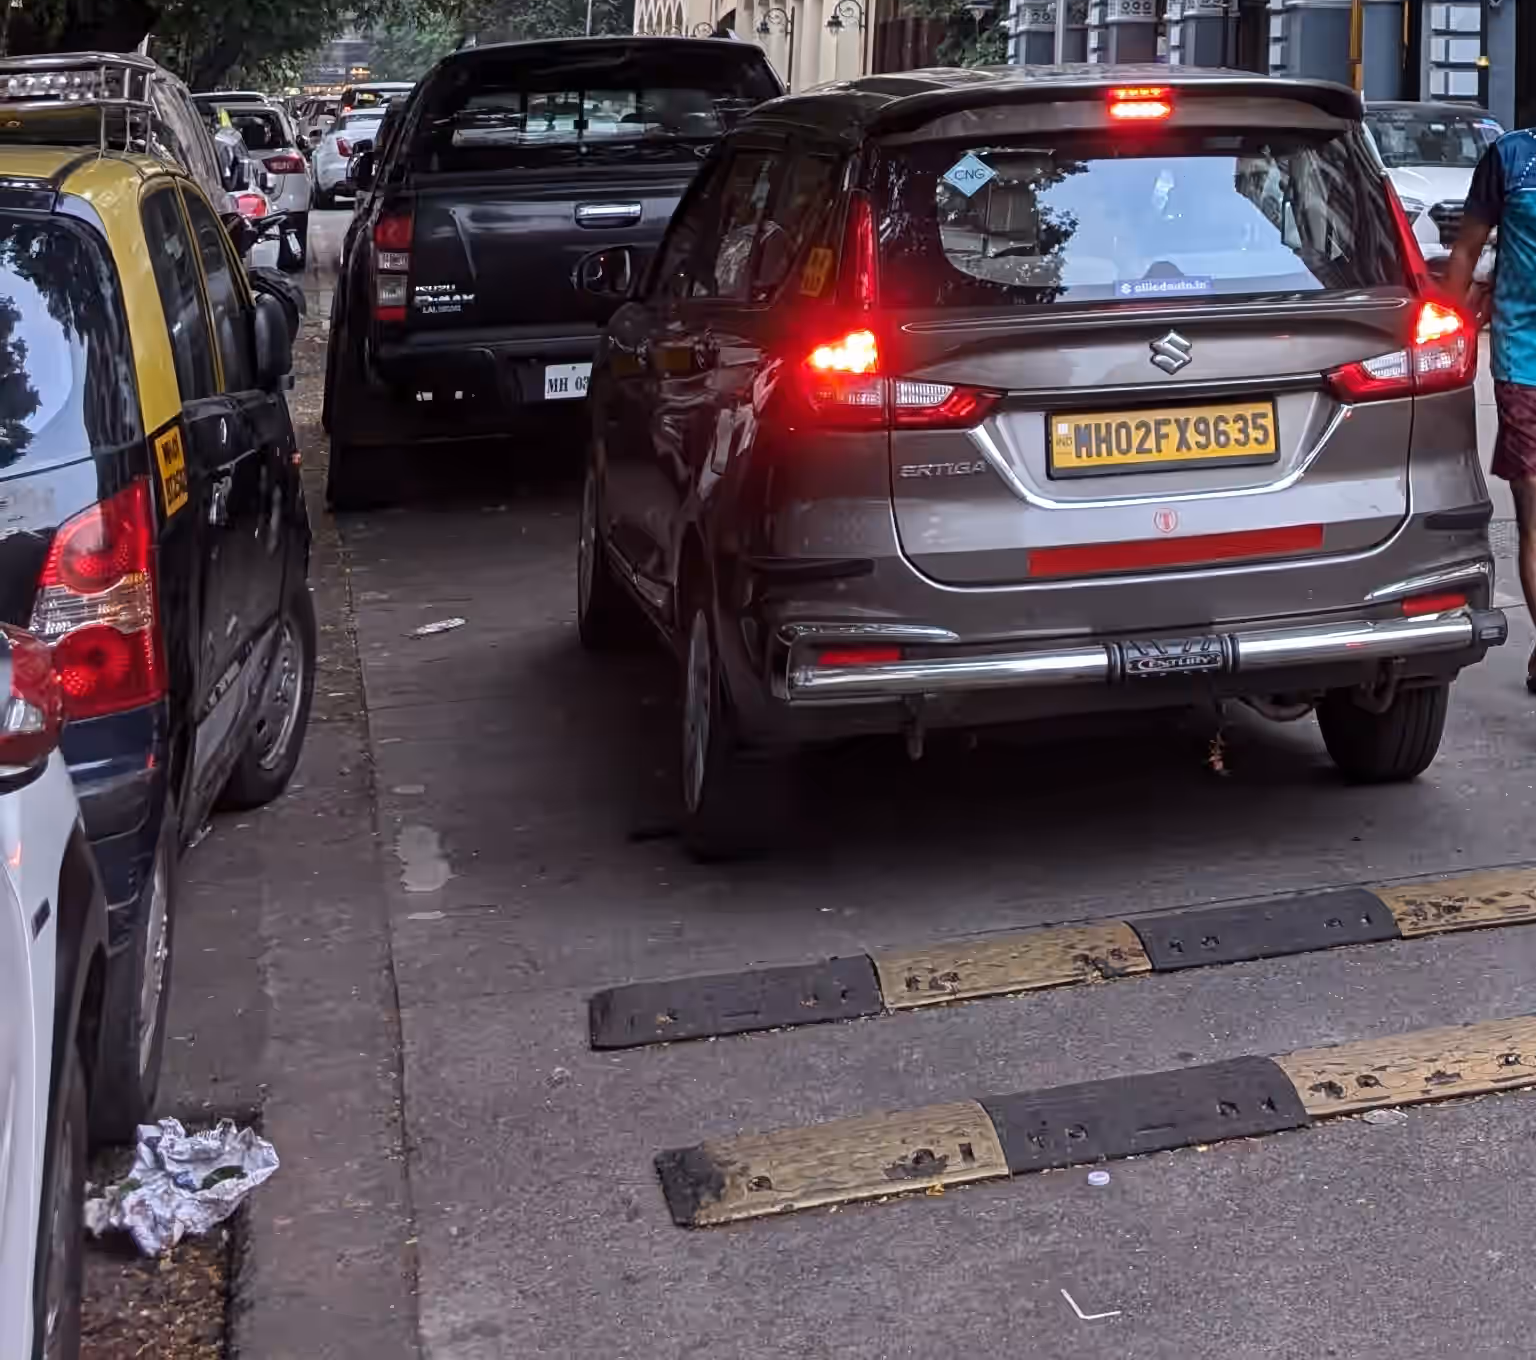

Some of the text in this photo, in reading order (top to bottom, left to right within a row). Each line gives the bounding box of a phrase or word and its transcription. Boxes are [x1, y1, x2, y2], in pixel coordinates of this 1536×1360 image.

[954, 168, 985, 181] CNG
[547, 377, 568, 394] MH
[1056, 411, 1270, 459] IND MH02FX9635
[899, 460, 986, 478] ERTIGA
